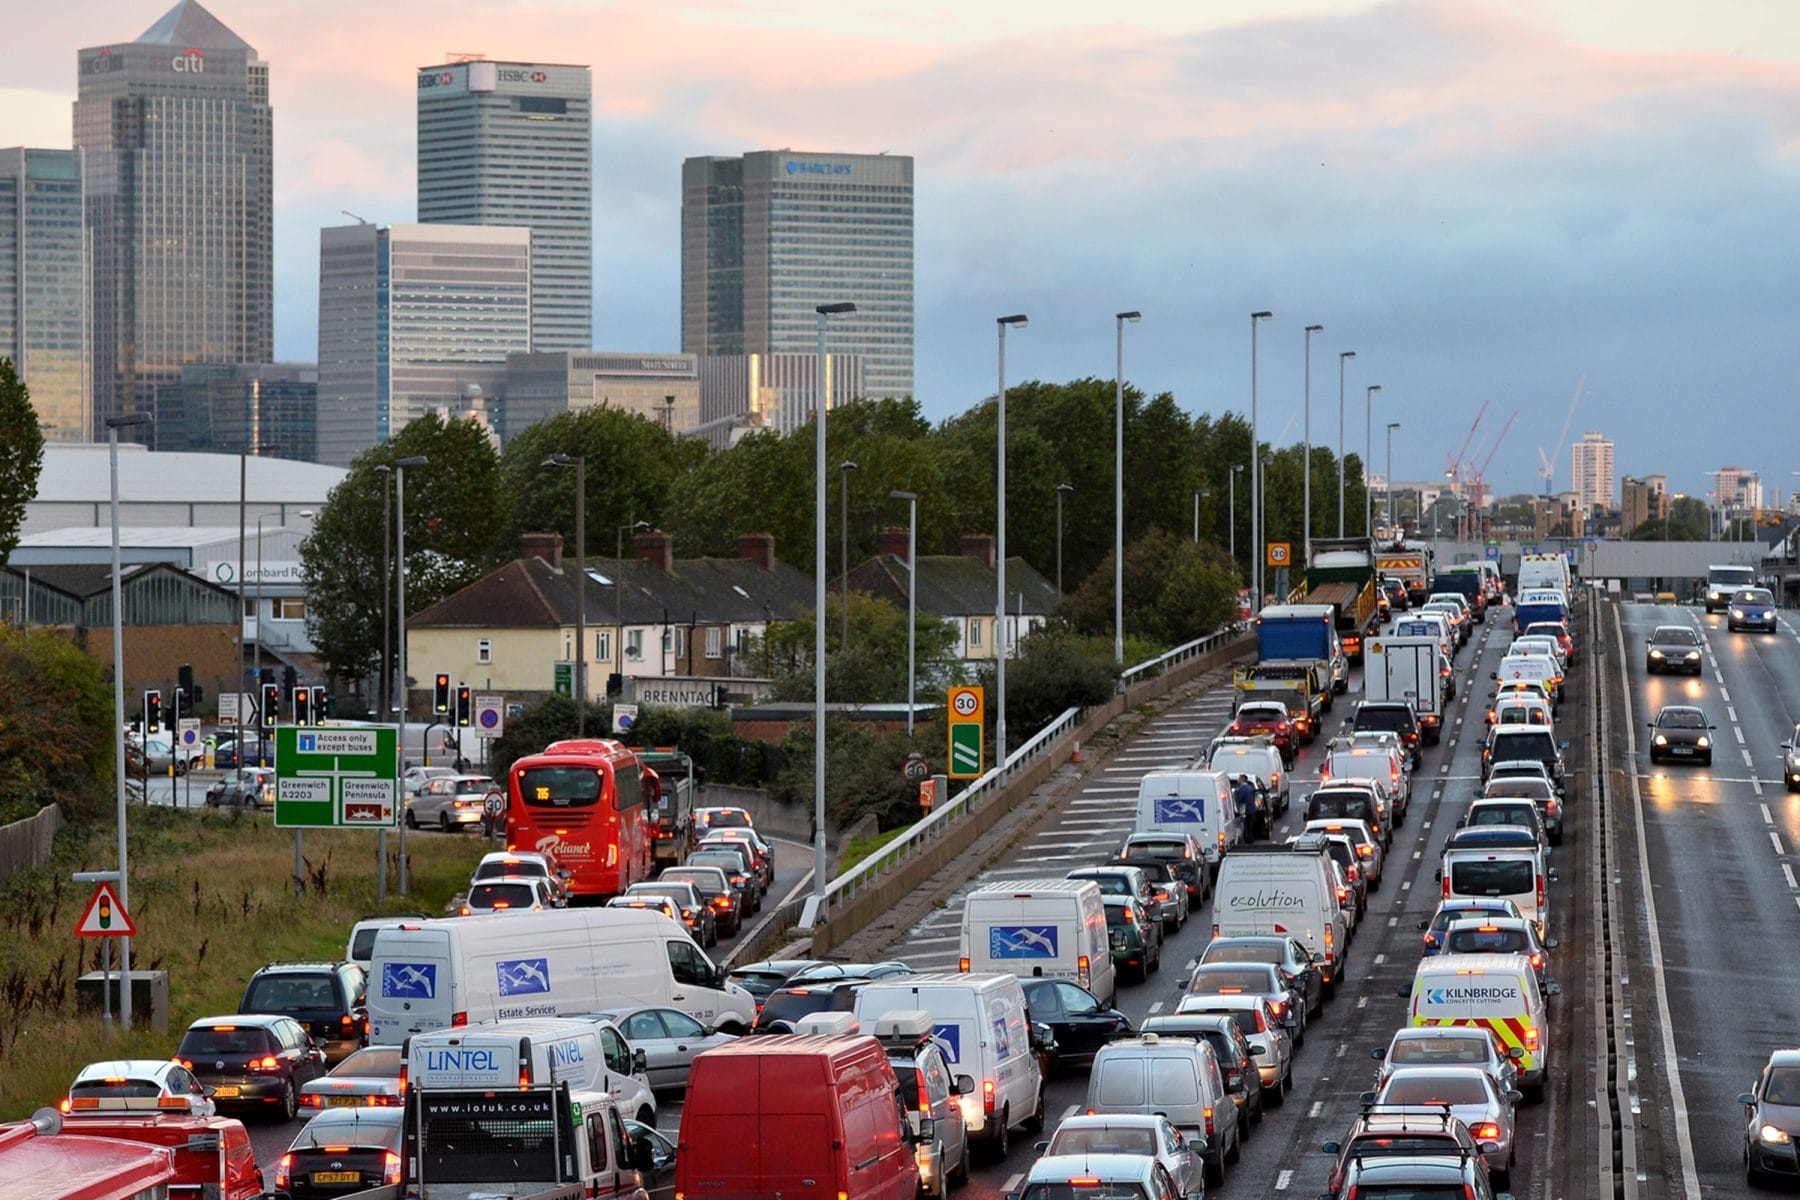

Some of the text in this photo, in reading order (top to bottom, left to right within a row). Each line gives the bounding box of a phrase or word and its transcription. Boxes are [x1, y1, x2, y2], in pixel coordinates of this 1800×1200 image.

[172, 53, 203, 72] citi
[498, 70, 529, 82] HSBC
[243, 567, 288, 577] ombard
[956, 698, 976, 709] 30
[317, 734, 367, 743] Access only
[317, 744, 345, 752] except
[281, 781, 326, 789] Greenwich
[345, 782, 390, 790] Greenwich
[281, 791, 312, 799] A2203
[345, 791, 386, 799] Peninsula
[486, 799, 500, 812] 30
[535, 835, 591, 863] Reliance
[1231, 889, 1304, 908] ecolution
[991, 928, 1001, 958] swan
[384, 963, 392, 997] swan
[498, 963, 508, 996] swan
[1446, 988, 1517, 998] KILNBRIDGE
[498, 1006, 556, 1019] Estate Services
